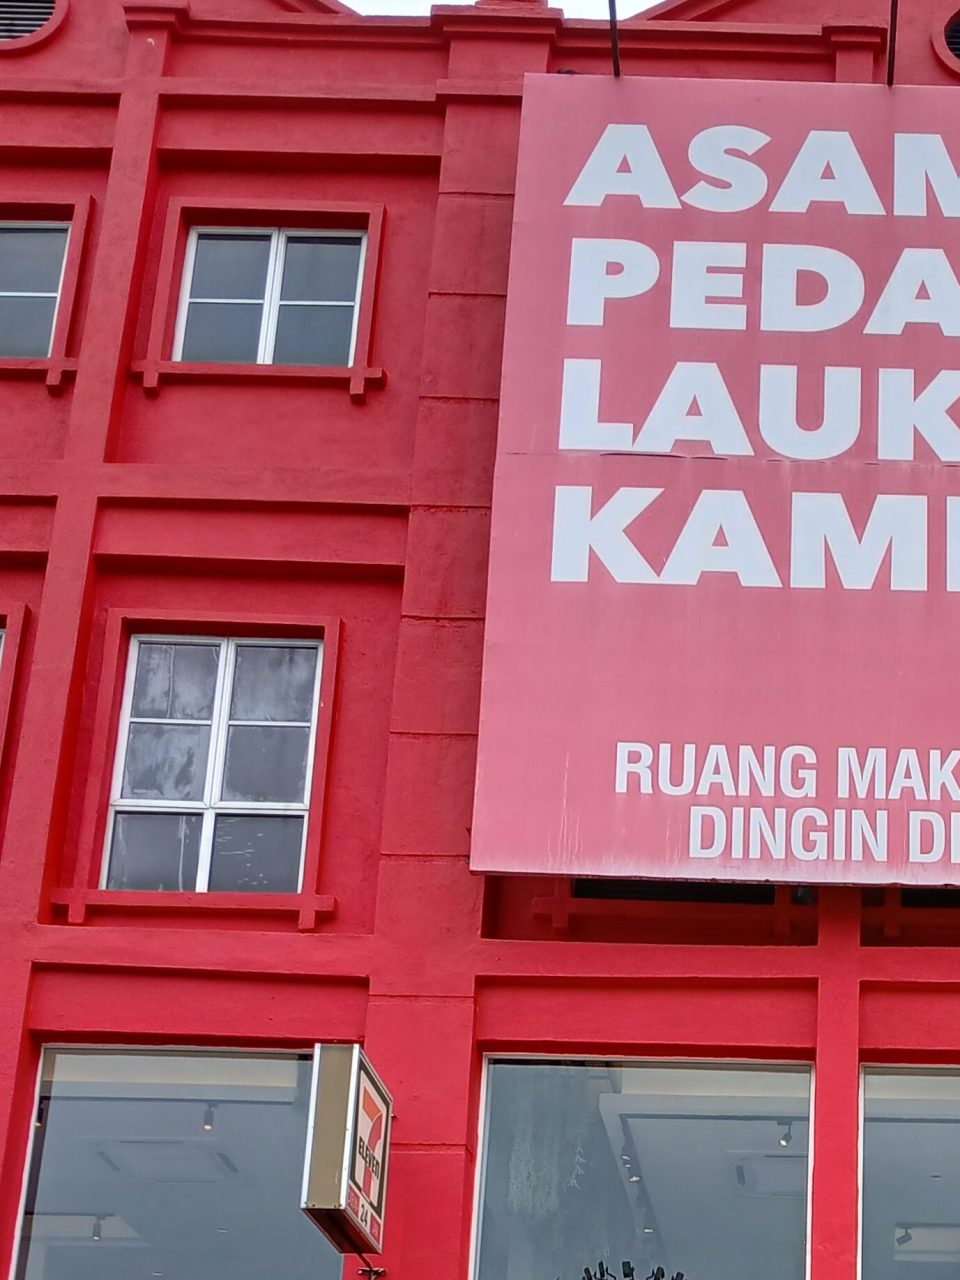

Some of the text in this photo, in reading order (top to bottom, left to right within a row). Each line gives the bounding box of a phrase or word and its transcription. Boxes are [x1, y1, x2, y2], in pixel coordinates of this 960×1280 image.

[614, 741, 817, 798] RUANG
[688, 805, 890, 864] DINGIN
[360, 1203, 368, 1228] 24
